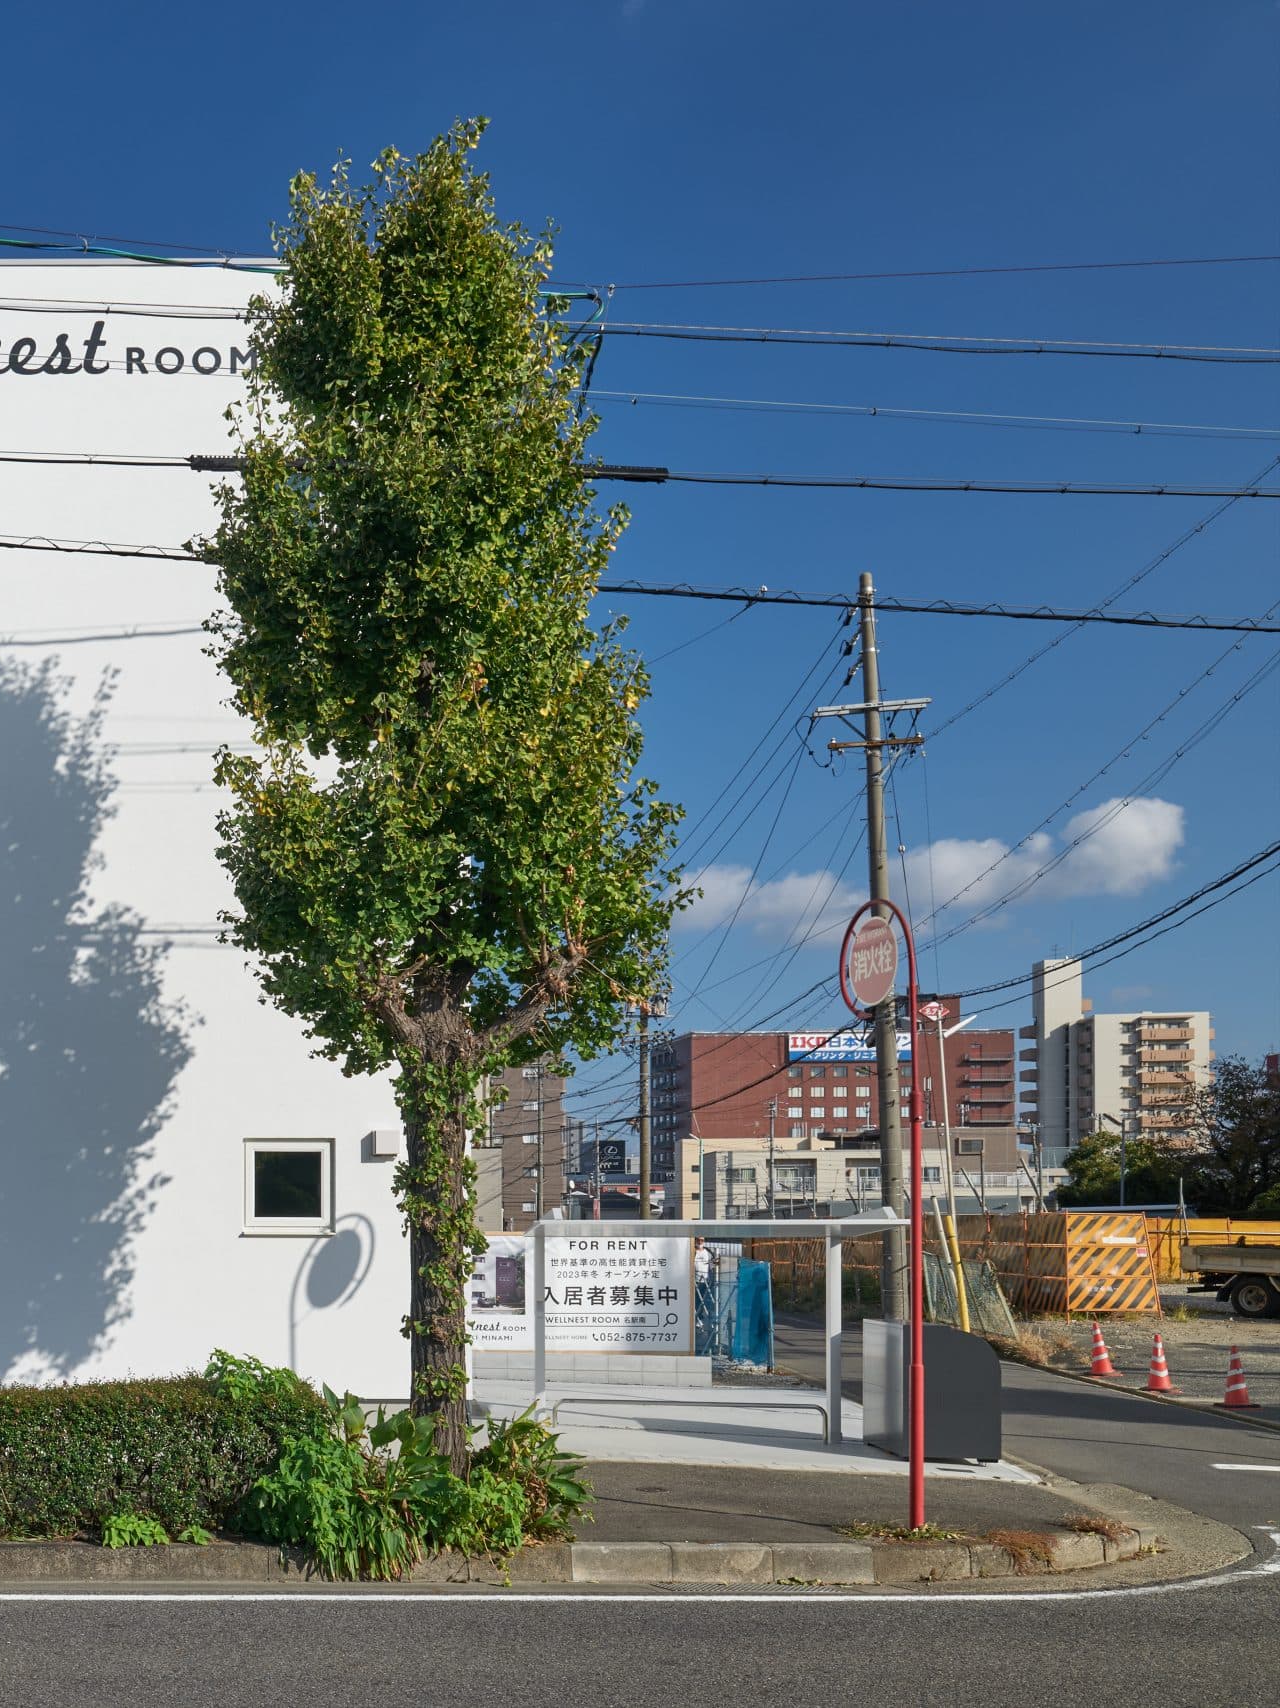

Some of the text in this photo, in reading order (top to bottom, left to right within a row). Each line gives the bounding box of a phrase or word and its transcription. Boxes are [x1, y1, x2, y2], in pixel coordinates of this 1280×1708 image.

[126, 346, 258, 375] ROOM
[853, 940, 895, 983] 消火栓
[569, 1240, 648, 1251] FOR RENT
[550, 1257, 668, 1268] 世界基準の高性能賃貸住宅
[557, 1270, 661, 1279] 2023年冬 オープン予定
[544, 1285, 678, 1306] 入居者募集中
[545, 1316, 646, 1325] WELLNEST ROOM 名駅南
[600, 1332, 678, 1342] 052-875-7737
